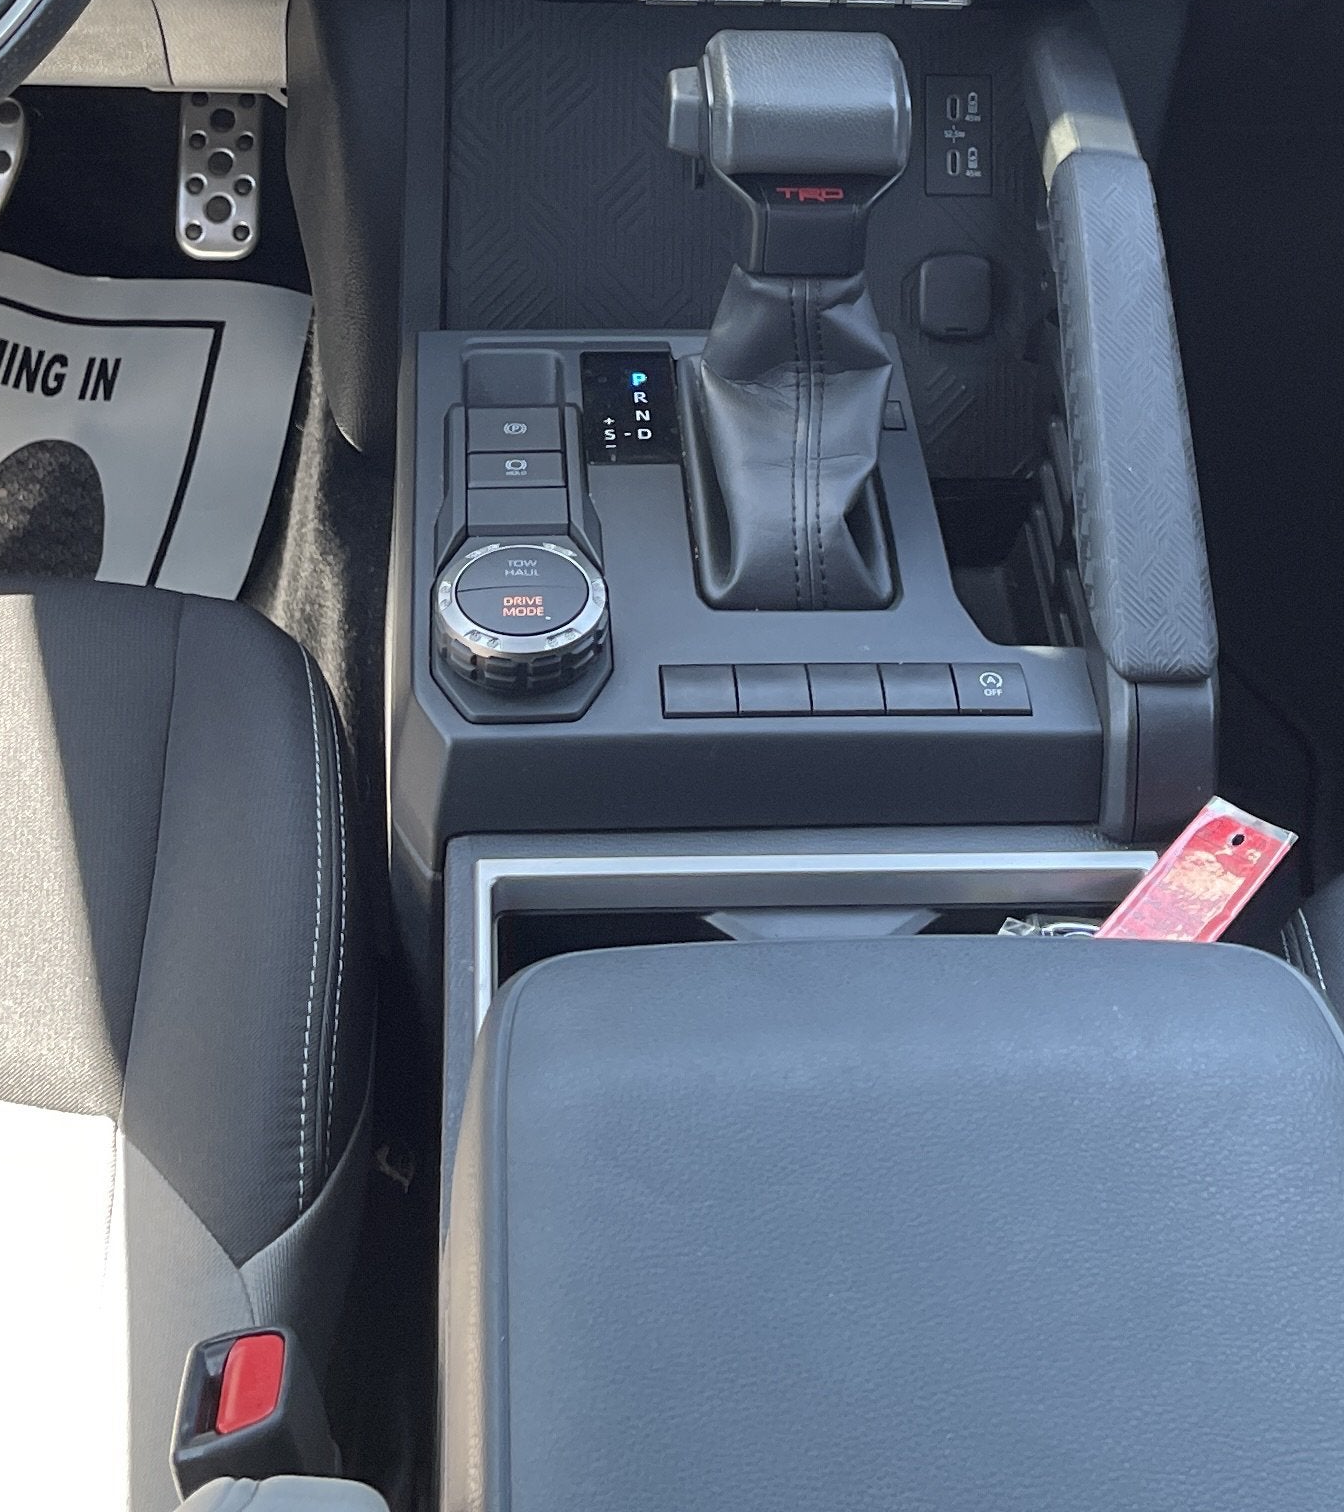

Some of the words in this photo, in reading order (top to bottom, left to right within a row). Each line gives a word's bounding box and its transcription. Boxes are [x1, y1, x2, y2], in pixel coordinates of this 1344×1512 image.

[775, 187, 844, 202] TRD
[77, 356, 122, 402] IN
[631, 372, 648, 386] P
[633, 391, 648, 404] R
[636, 409, 650, 422] N
[604, 428, 616, 441] S
[637, 428, 652, 441] D
[507, 559, 537, 568] TOW
[504, 568, 540, 577] HAUL
[503, 596, 543, 606] DRIVE
[502, 606, 545, 617] MODE
[983, 688, 1003, 697] OFF
